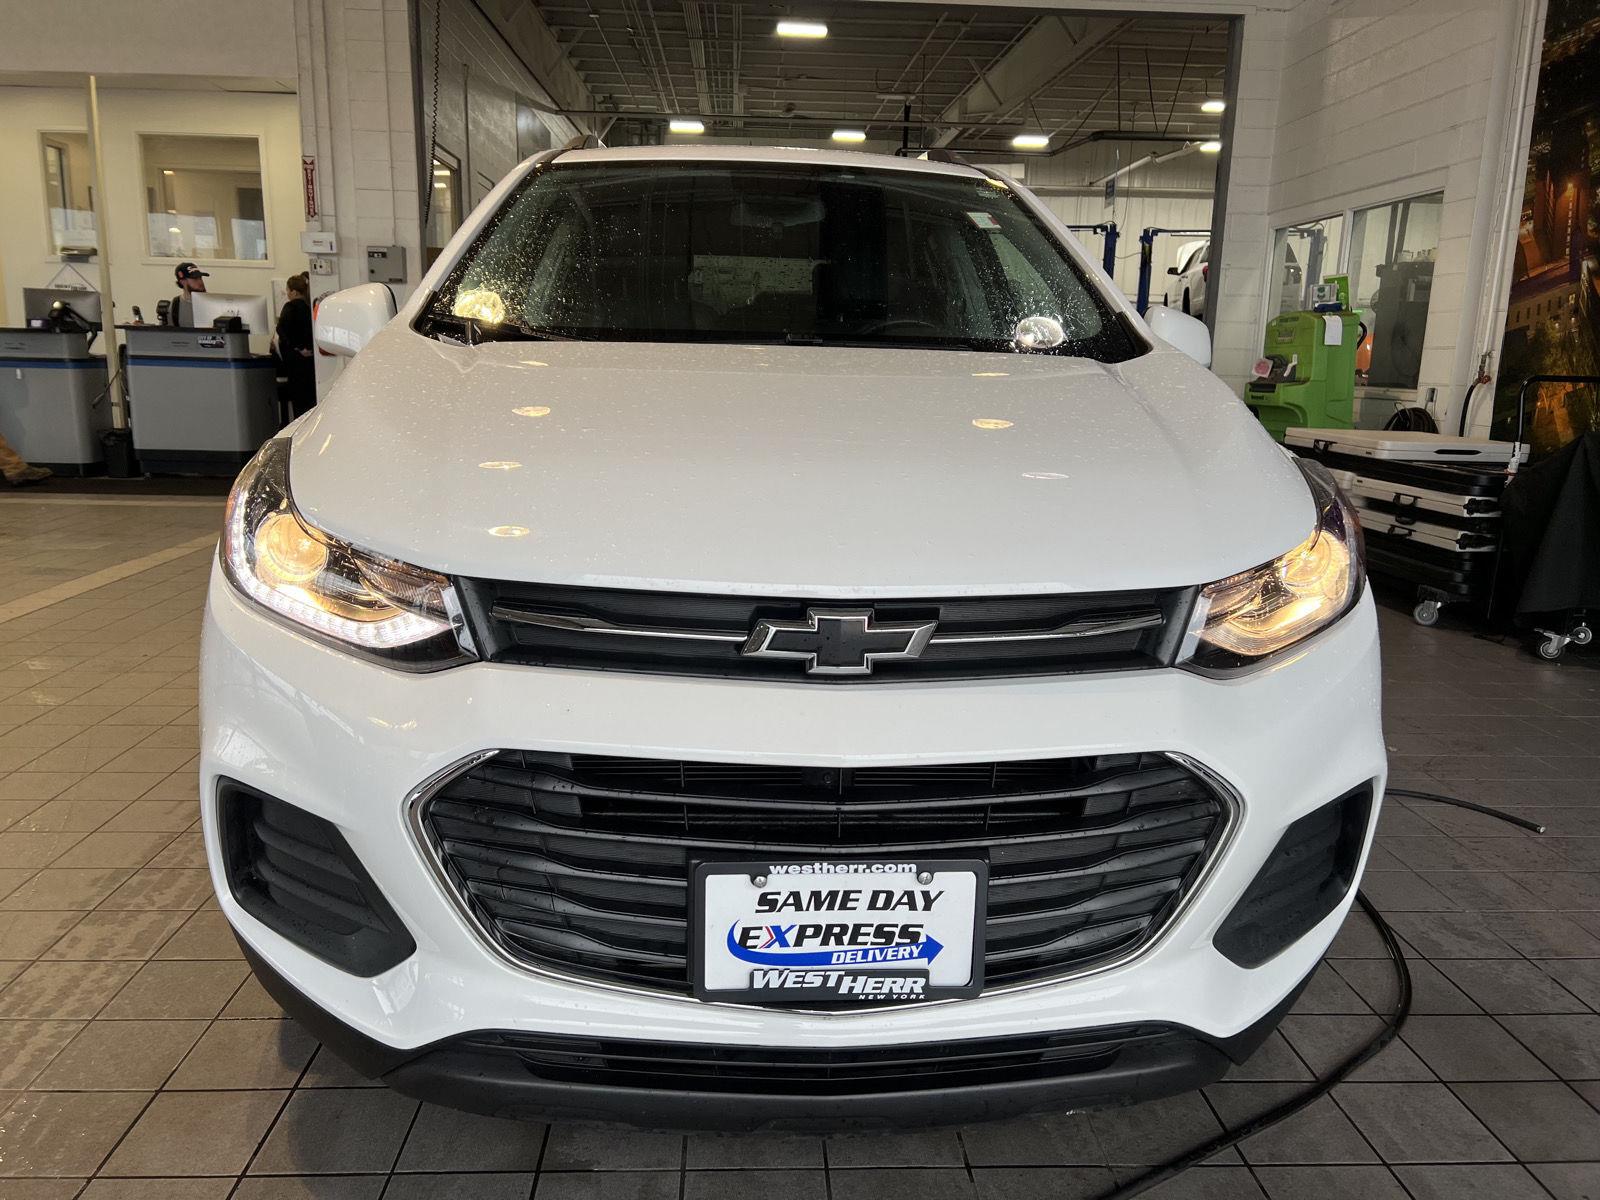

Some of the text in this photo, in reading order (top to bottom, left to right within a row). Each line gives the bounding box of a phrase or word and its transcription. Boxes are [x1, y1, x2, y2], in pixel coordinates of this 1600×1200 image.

[769, 863, 917, 875] westherr.com
[755, 890, 944, 913] SAME DAY
[738, 923, 924, 949] EXPRESS
[831, 945, 923, 964] DELIVERY
